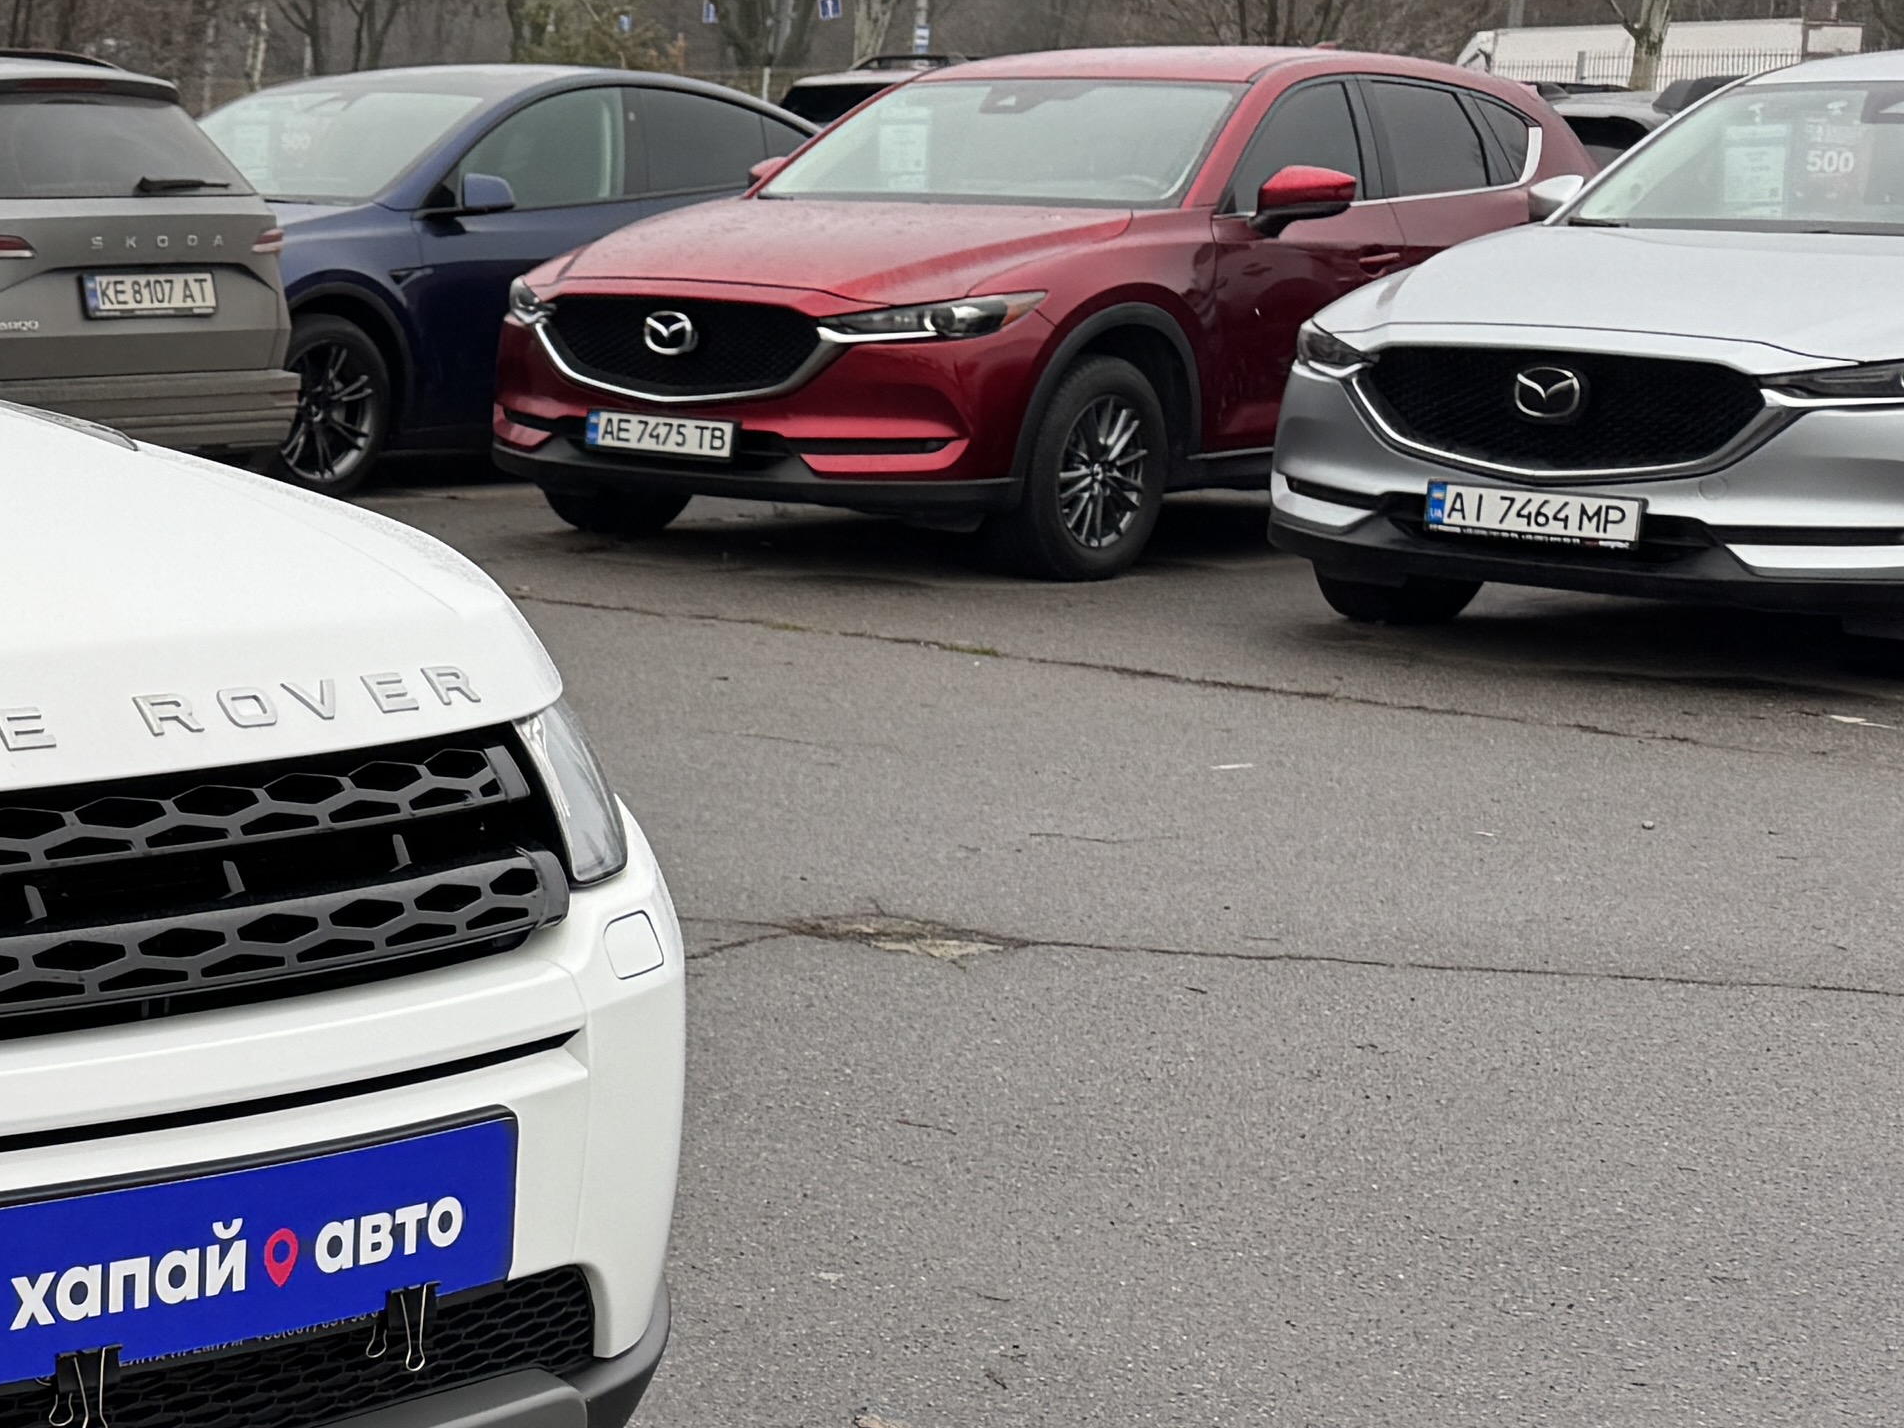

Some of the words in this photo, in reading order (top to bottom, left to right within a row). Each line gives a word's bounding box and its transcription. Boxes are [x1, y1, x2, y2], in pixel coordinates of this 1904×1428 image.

[98, 280, 129, 305] KE
[132, 278, 174, 304] 8107
[182, 278, 208, 303] AT
[601, 418, 631, 443] AE
[637, 420, 687, 447] 7475
[694, 425, 726, 450] TB
[1447, 492, 1483, 522] AI
[1499, 495, 1570, 531] 7464
[1578, 503, 1626, 534] MP
[131, 664, 483, 737] ROVER
[9, 1217, 247, 1332] хапай
[314, 1195, 464, 1274] авто
